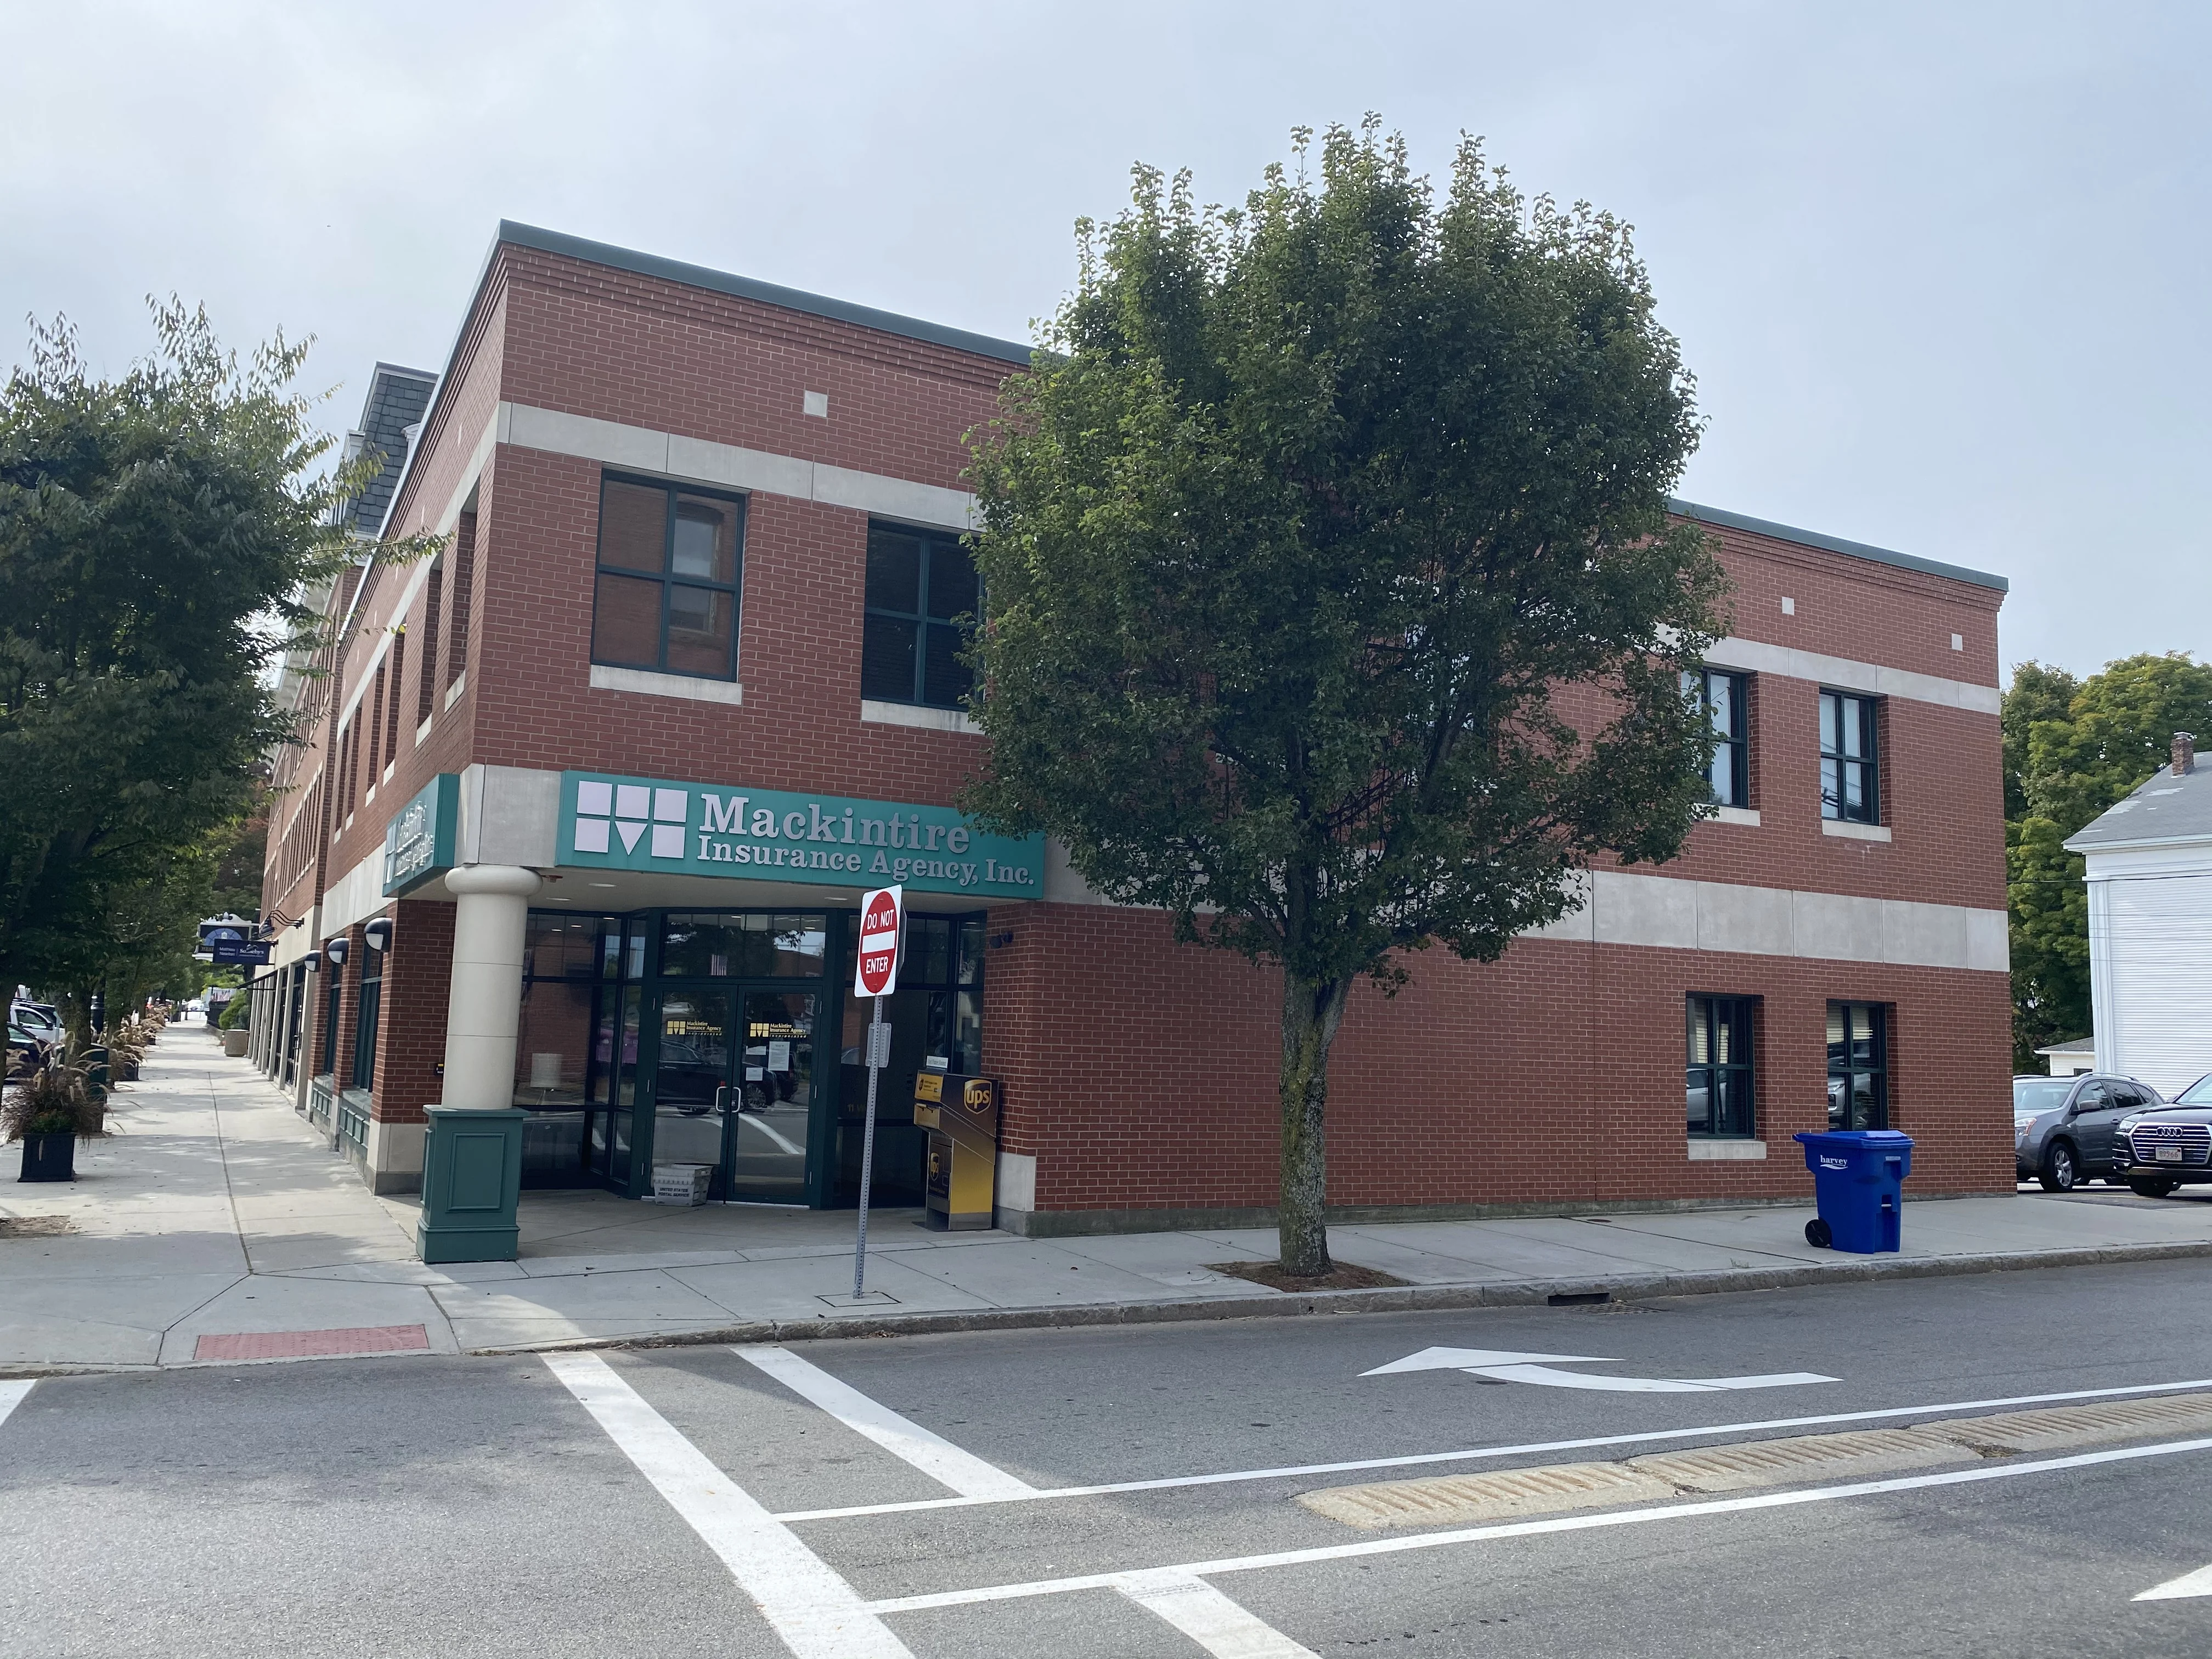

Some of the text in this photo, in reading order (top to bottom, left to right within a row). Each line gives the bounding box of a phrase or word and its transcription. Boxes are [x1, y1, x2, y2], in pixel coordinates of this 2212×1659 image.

[698, 793, 969, 854] Mackintire
[697, 834, 1034, 886] Insurance Agency, Inc.
[867, 909, 895, 930] DO NOT
[865, 956, 888, 974] ENTER
[966, 1090, 990, 1109] ups
[1820, 1154, 1848, 1167] harvey
